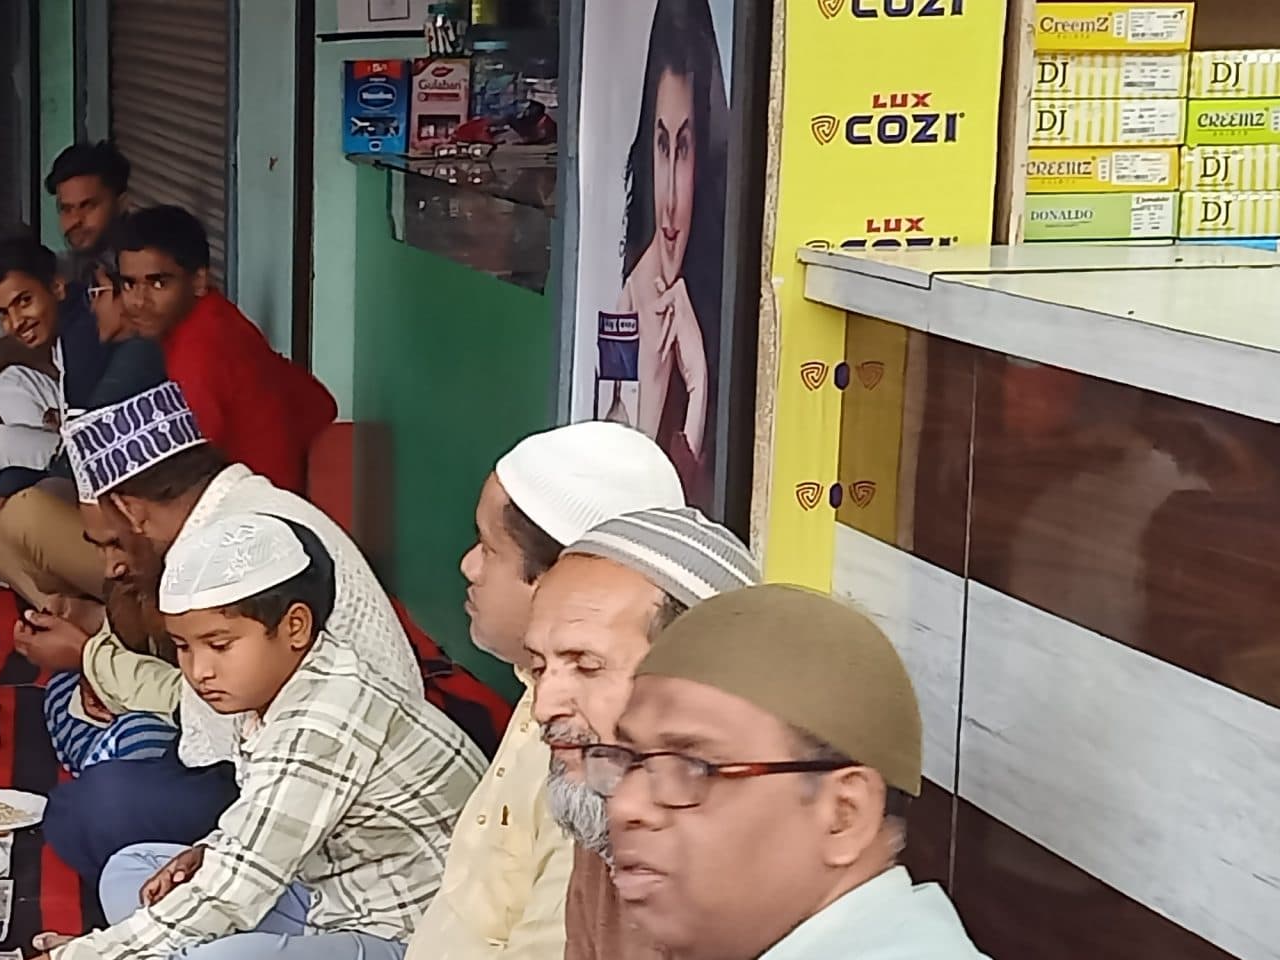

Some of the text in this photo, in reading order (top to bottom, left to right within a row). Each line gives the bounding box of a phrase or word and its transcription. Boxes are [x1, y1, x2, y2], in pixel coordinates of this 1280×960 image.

[1040, 16, 1109, 33] CreemZ
[1037, 62, 1069, 88] DJ
[1210, 61, 1242, 87] DJ
[872, 92, 932, 109] LUX
[845, 113, 958, 145] COZI
[1036, 110, 1067, 135] DJ
[1200, 155, 1231, 181] DJ
[866, 217, 925, 233] LUX
[1030, 209, 1093, 220] DONALDO
[1201, 200, 1232, 226] DJ
